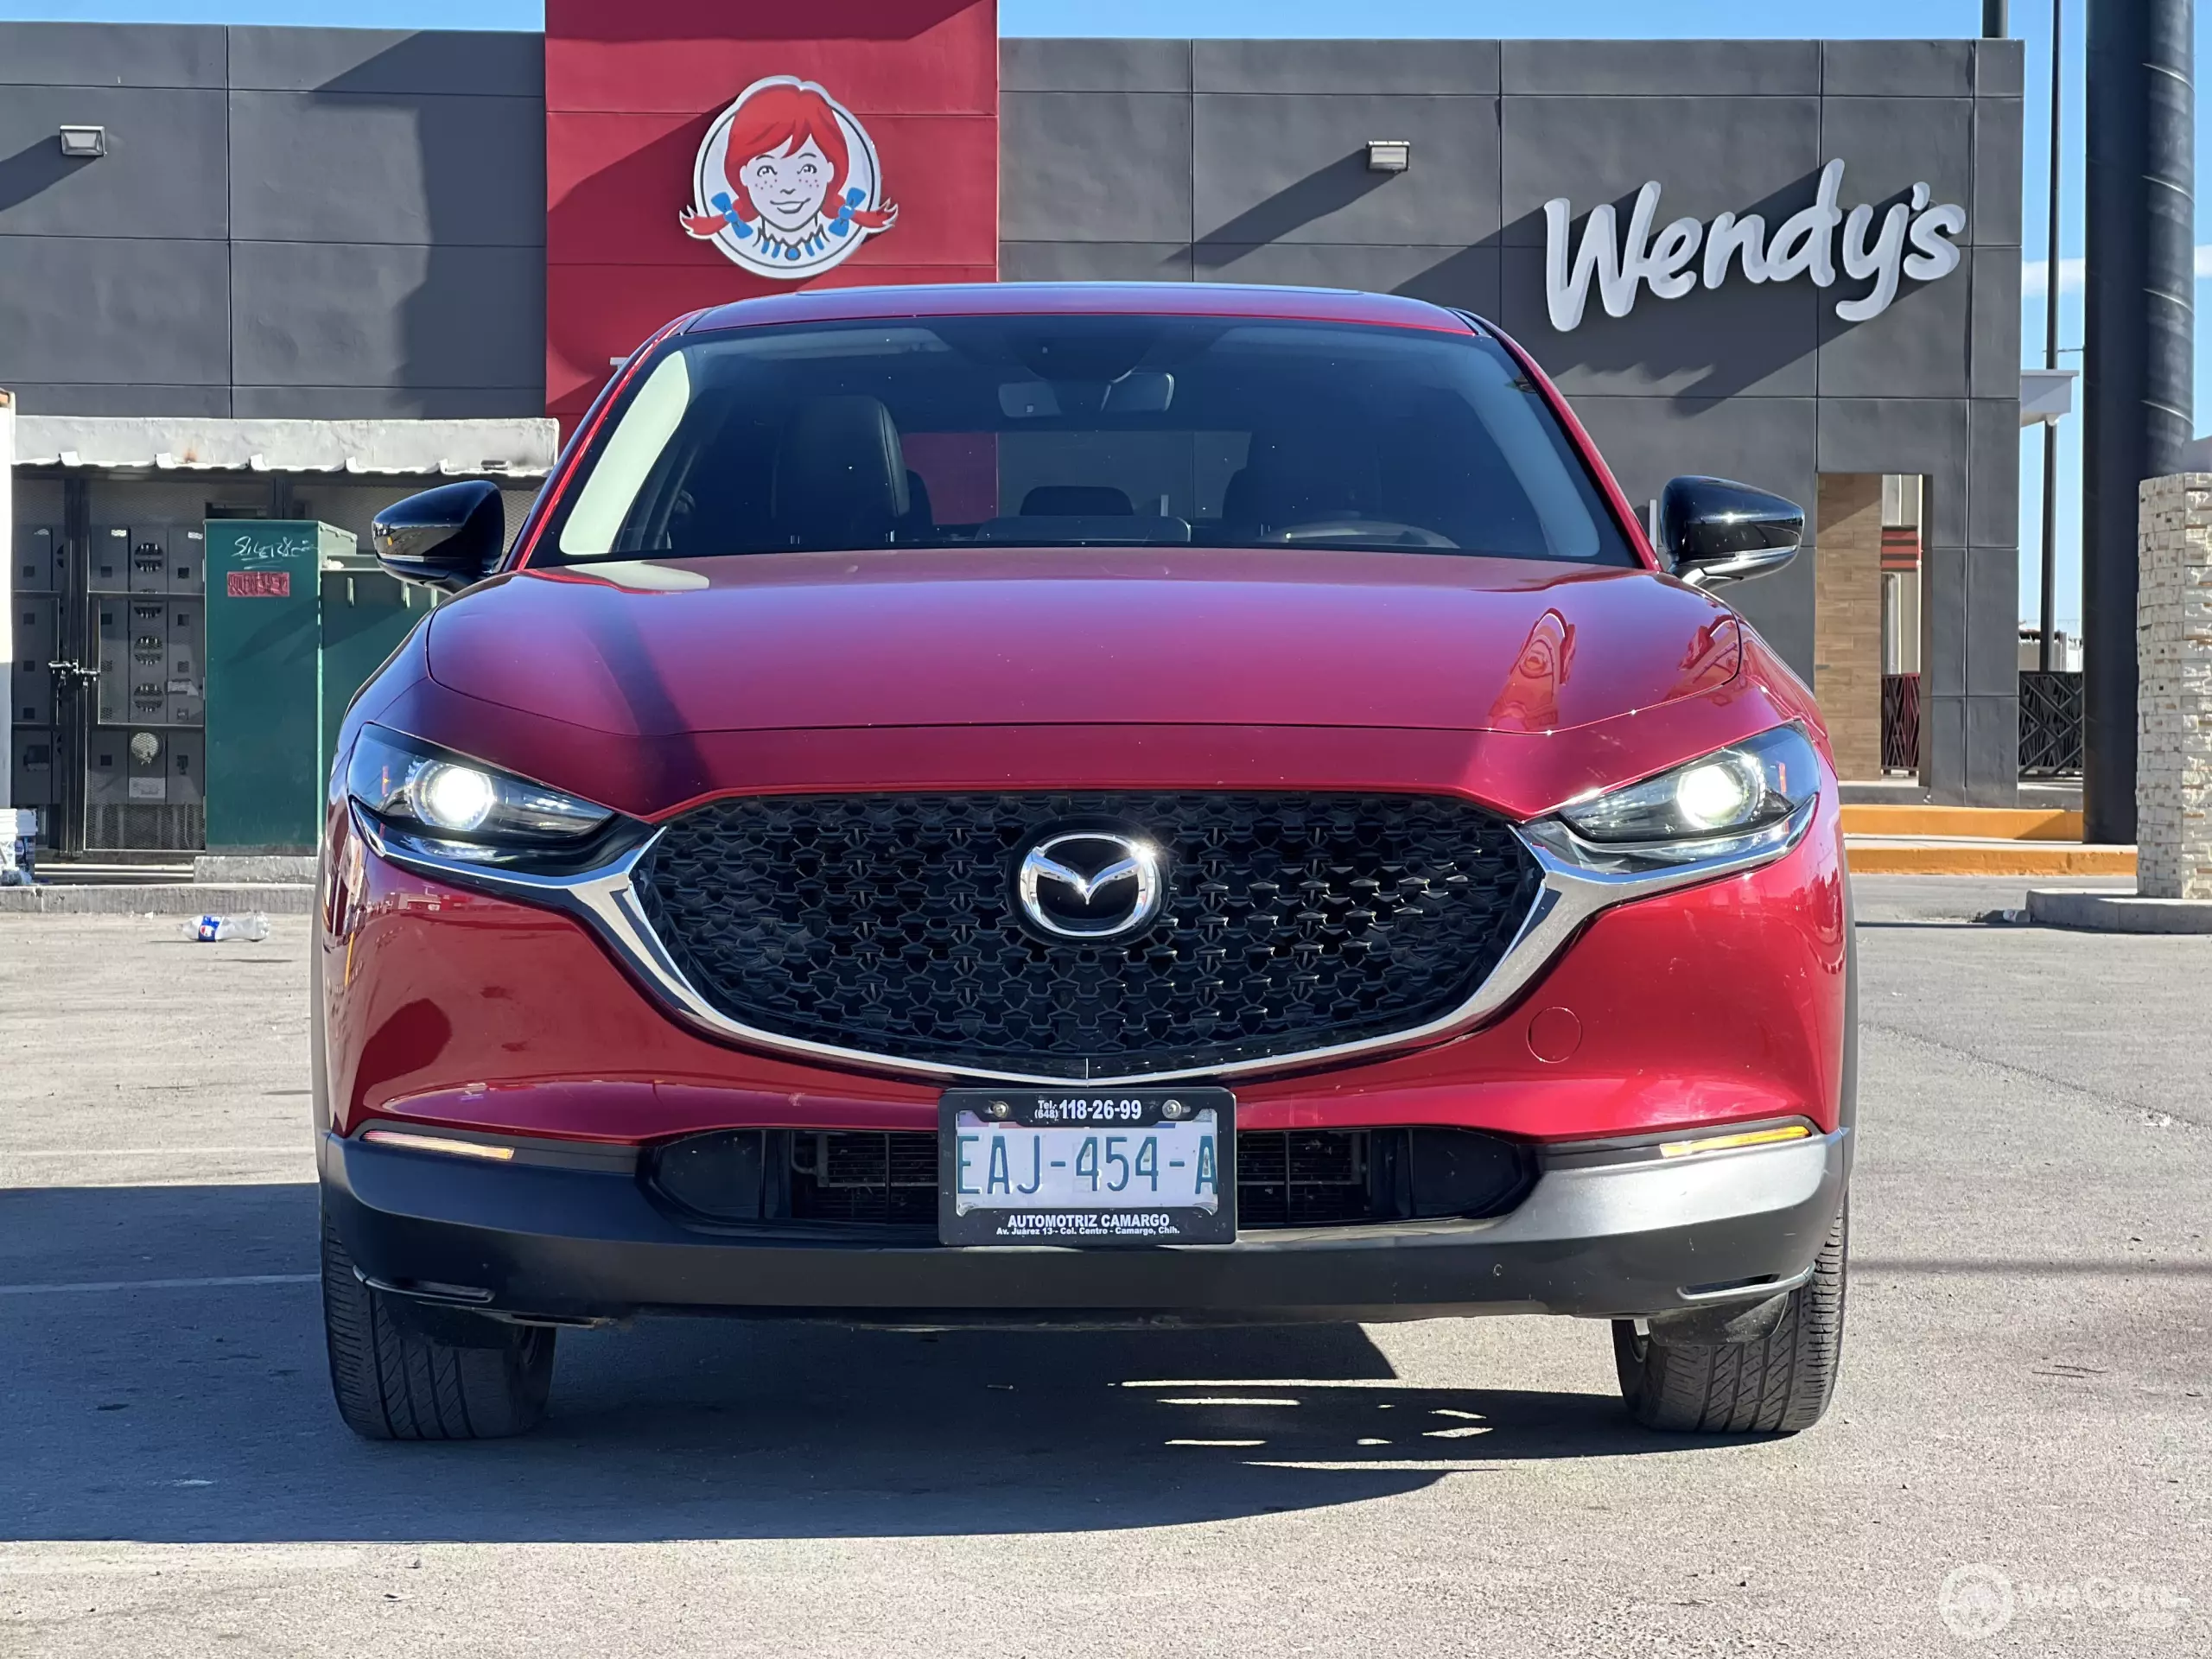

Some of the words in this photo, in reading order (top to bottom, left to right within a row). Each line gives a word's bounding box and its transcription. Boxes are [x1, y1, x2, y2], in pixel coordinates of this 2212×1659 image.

[1543, 158, 1966, 332] Wendy's
[1034, 1109, 1058, 1119] (648)
[1058, 1099, 1142, 1120] 118-26-99
[957, 1135, 1218, 1194] EAJ-454-A
[1007, 1214, 1097, 1228] AUTOMOTRIZ
[1101, 1214, 1170, 1227] CAMARGO
[1011, 1226, 1039, 1235] Juárez
[1079, 1226, 1108, 1235] Centro
[1115, 1226, 1156, 1236] Camargo,
